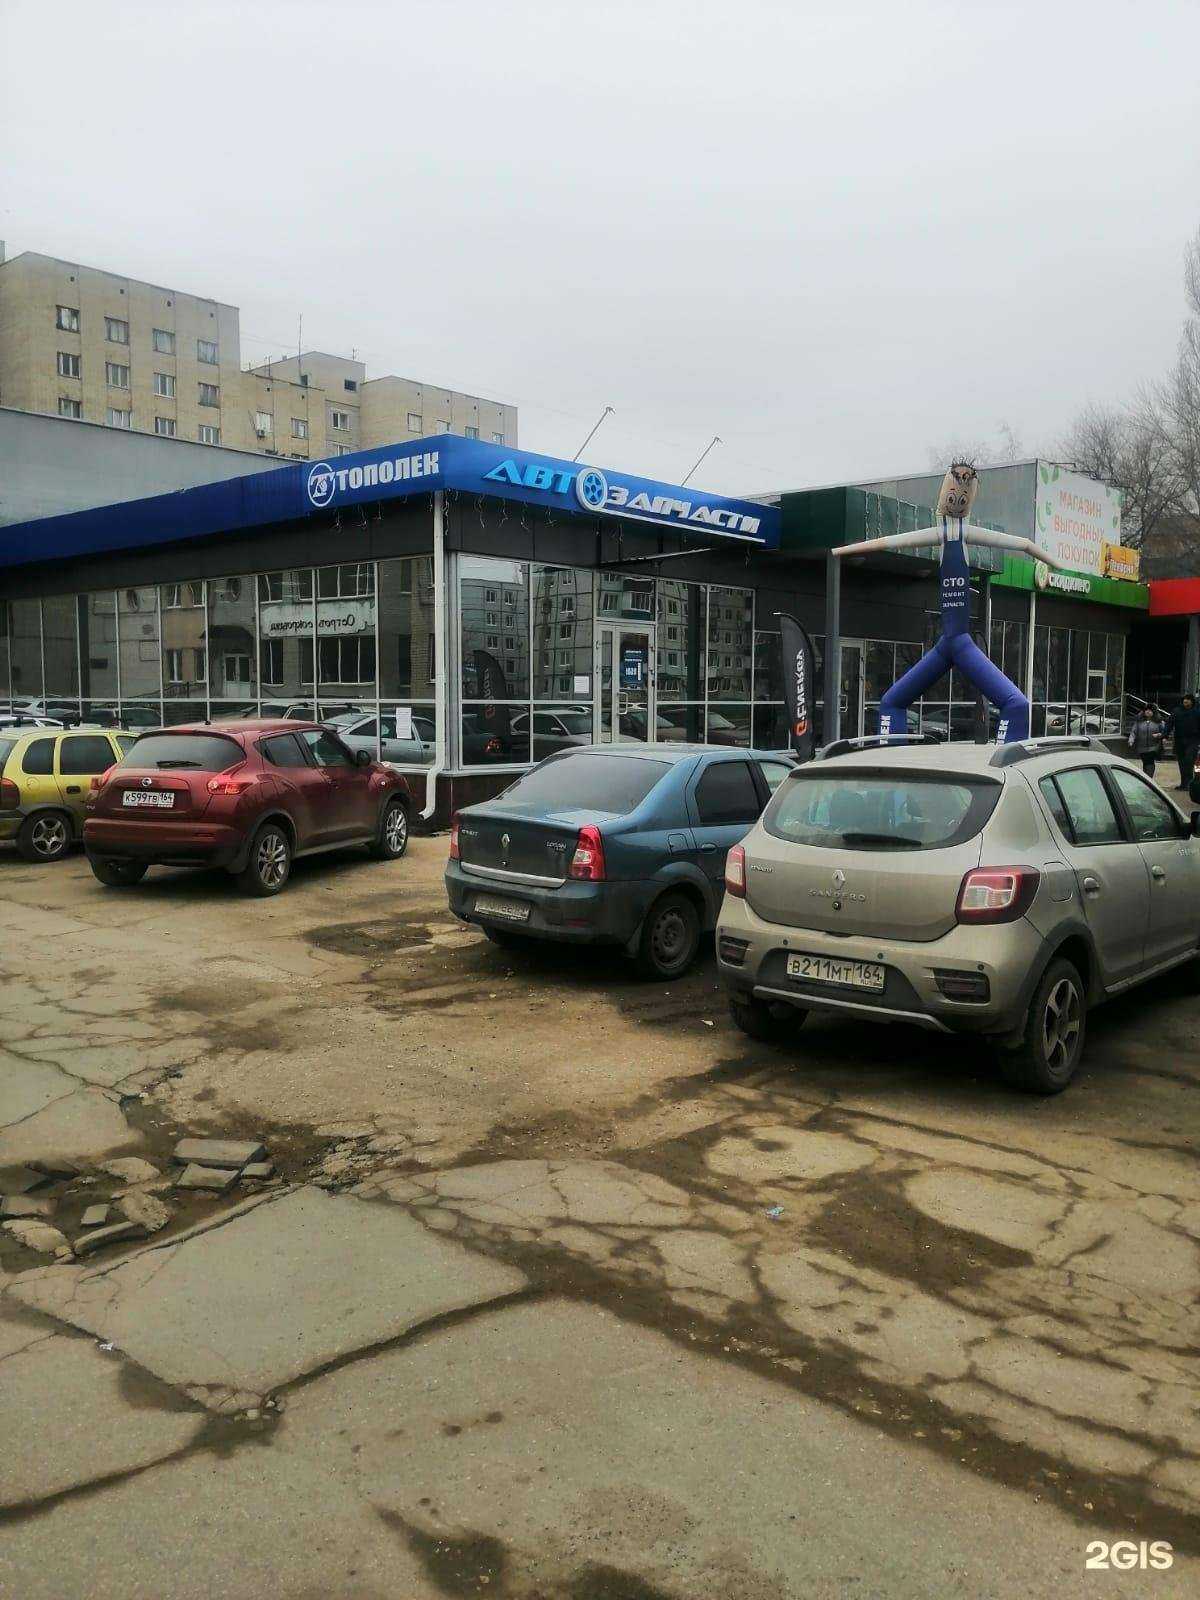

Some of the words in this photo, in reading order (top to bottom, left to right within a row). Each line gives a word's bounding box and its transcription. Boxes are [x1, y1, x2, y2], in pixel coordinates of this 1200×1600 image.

[335, 451, 440, 492] ТОПОЛЕК
[1058, 490, 1102, 517] МАГАЗИН
[943, 577, 965, 587] СТО
[855, 964, 881, 981] 164
